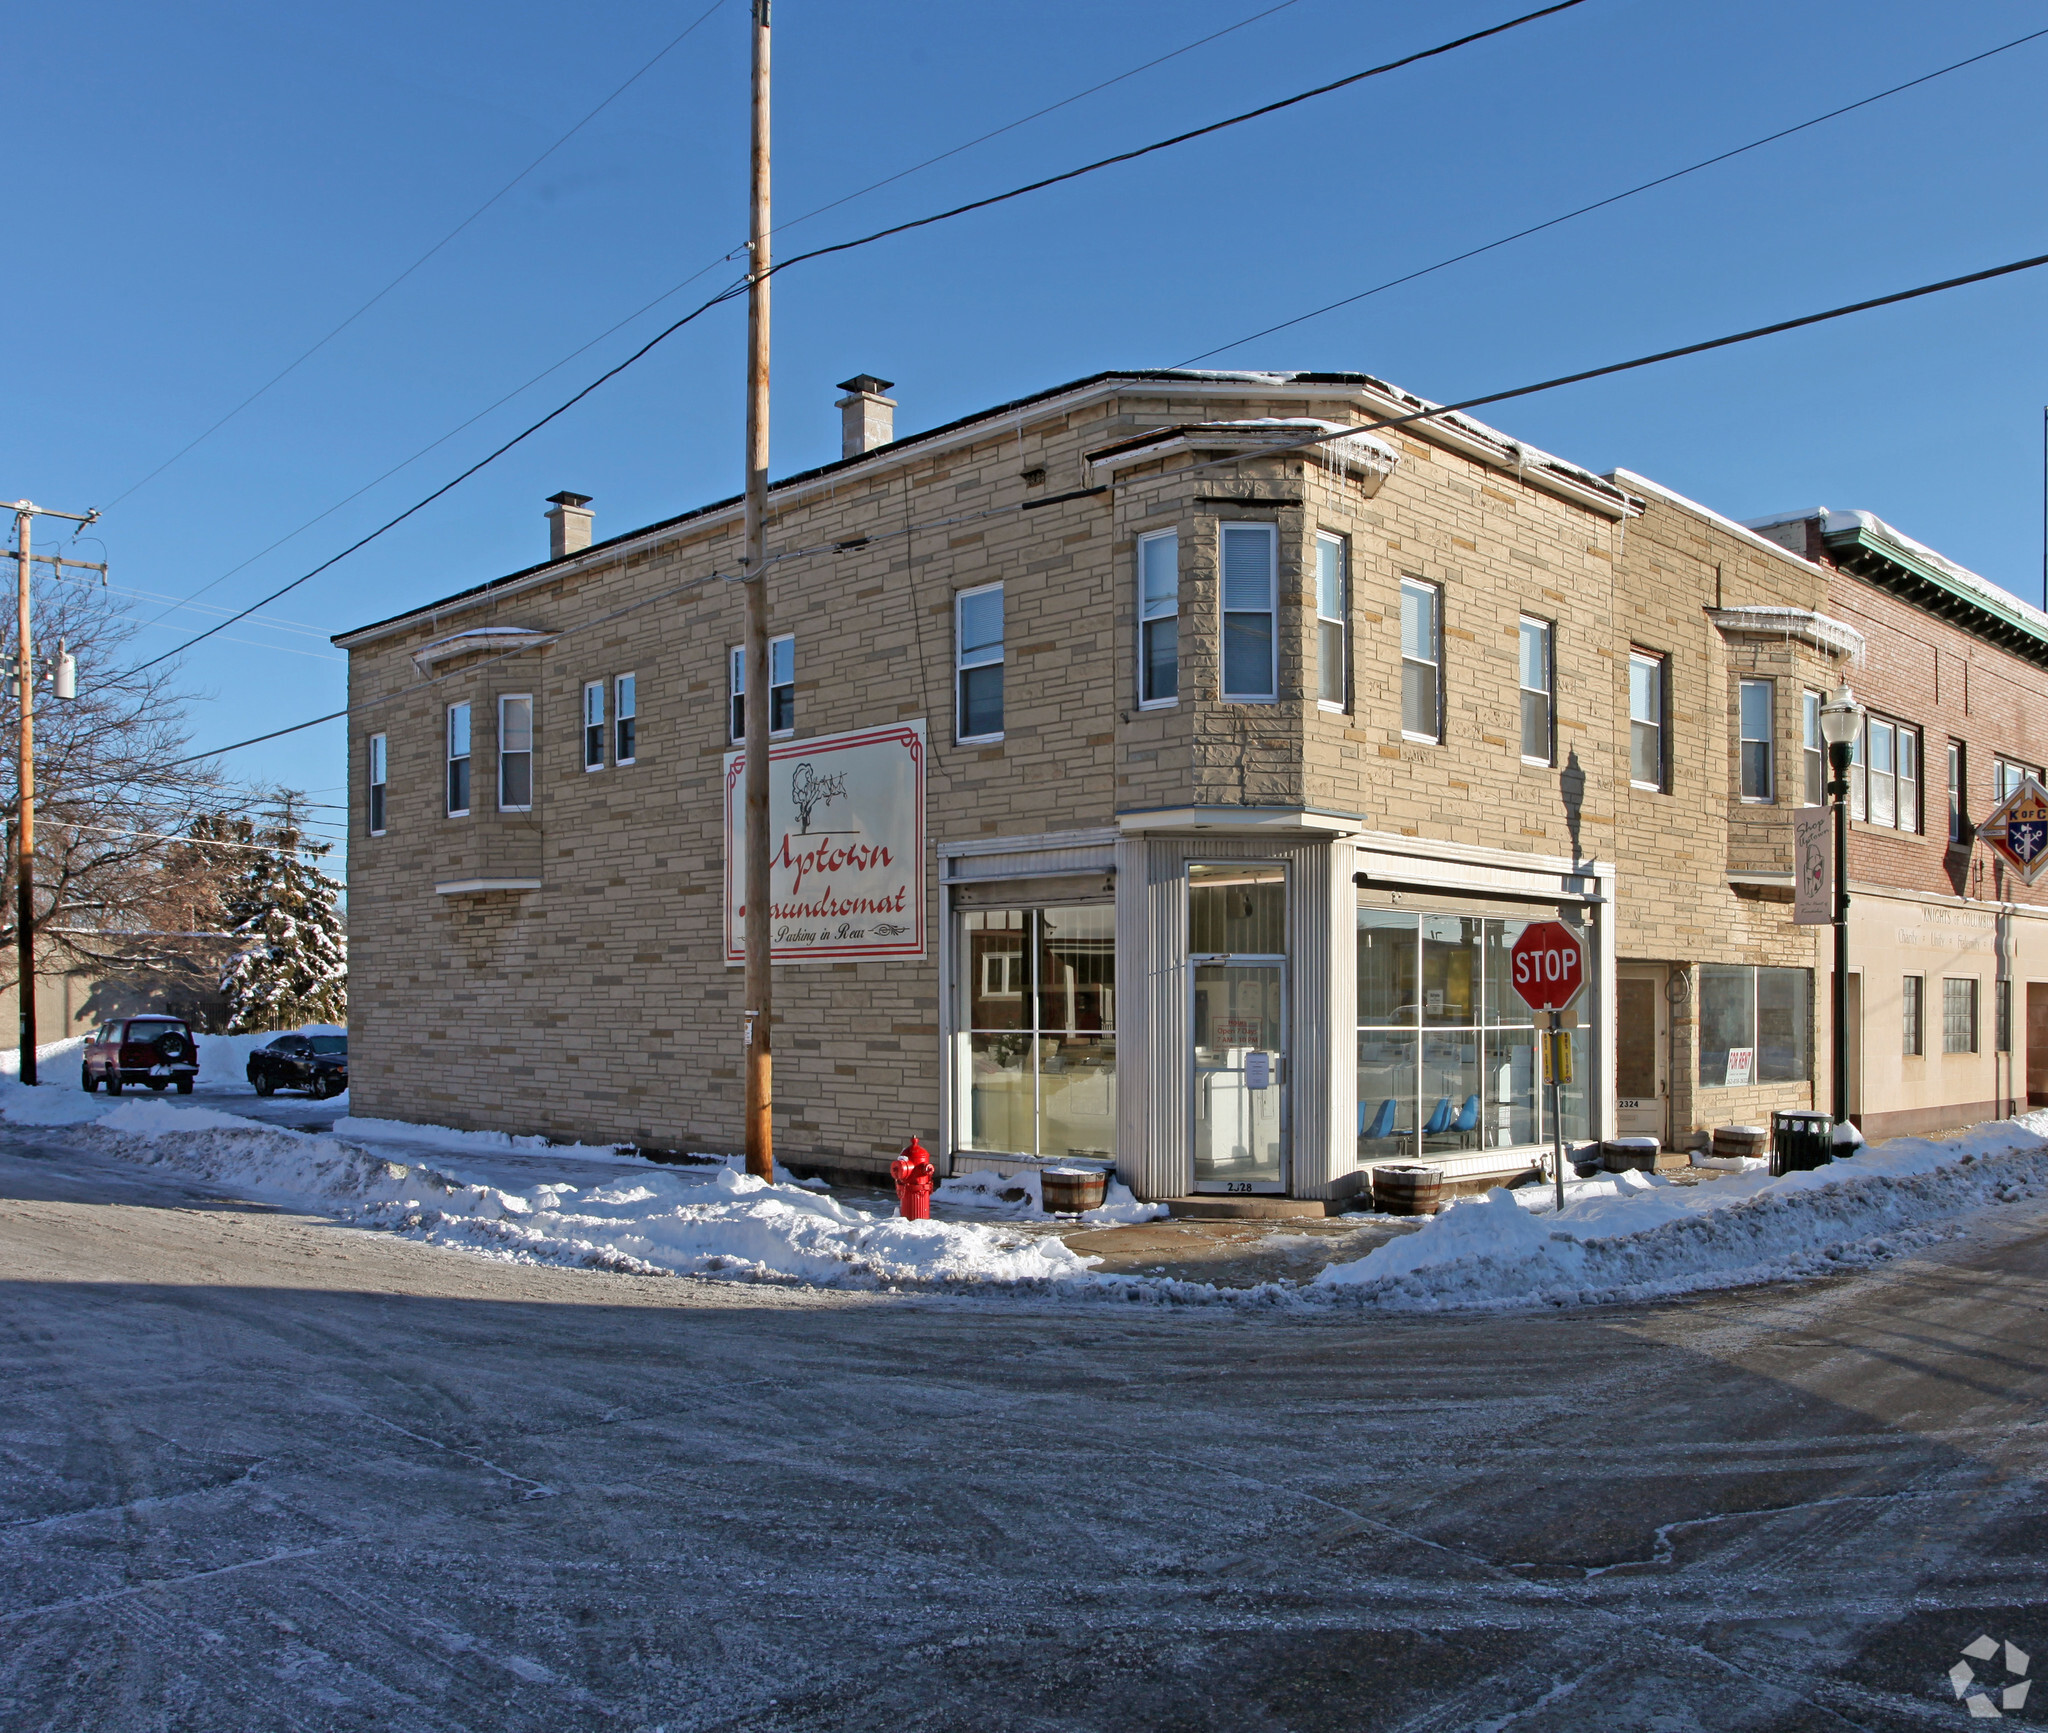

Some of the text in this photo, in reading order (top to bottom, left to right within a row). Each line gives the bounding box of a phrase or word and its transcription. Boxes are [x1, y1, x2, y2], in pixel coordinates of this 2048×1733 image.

[2010, 810, 2019, 820] K
[2037, 809, 2047, 820] C
[1796, 819, 1825, 839] Shop
[1799, 829, 1830, 848] Uptown
[739, 885, 906, 920] aundromat
[1921, 907, 1951, 925] KNIGHTS
[1962, 912, 1995, 930] COLUMBUS
[774, 922, 865, 945] Parking in Rear
[1516, 949, 1577, 983] STOP
[1729, 1052, 1751, 1069] FOR RENT
